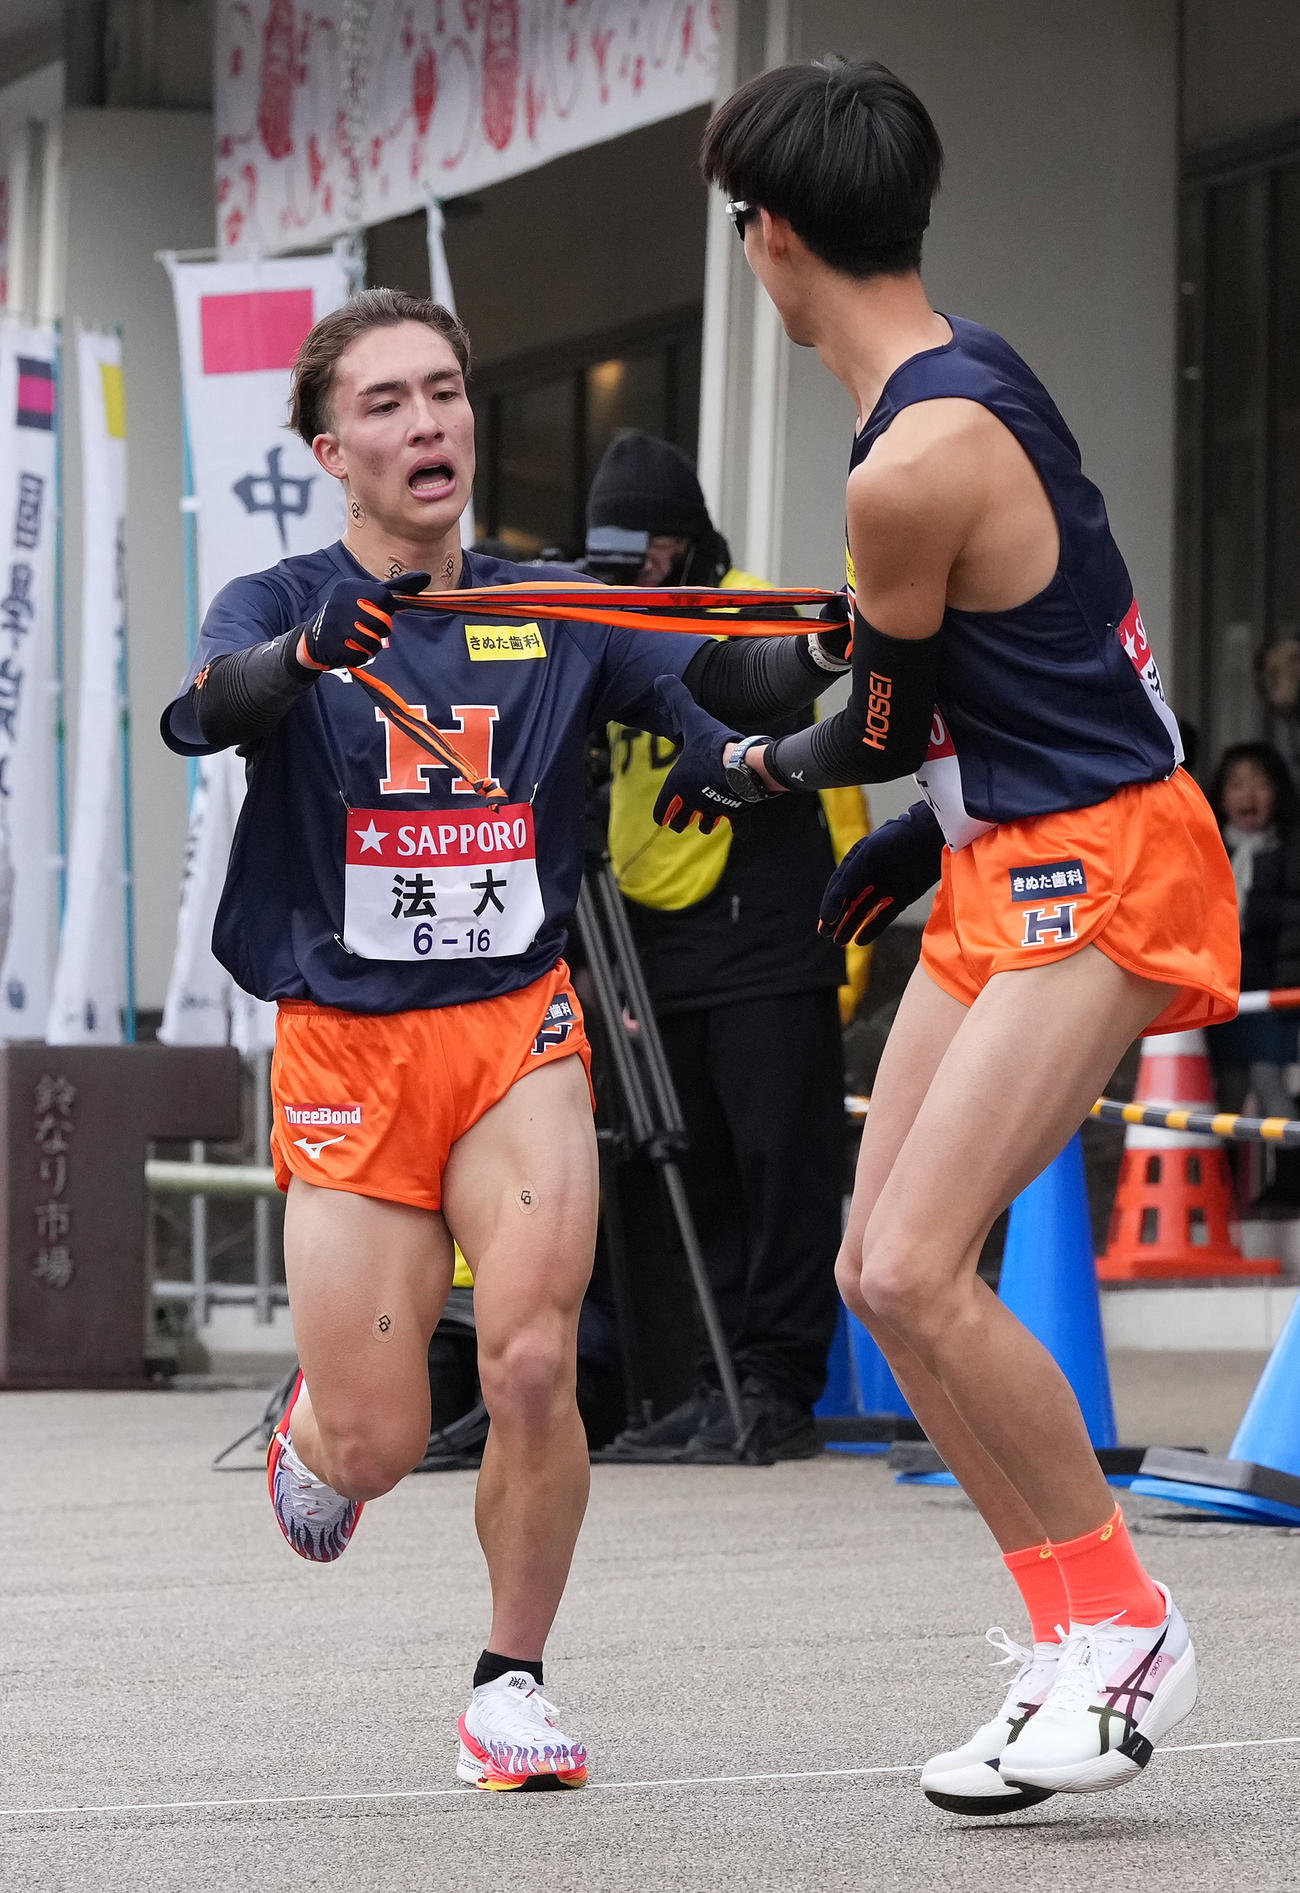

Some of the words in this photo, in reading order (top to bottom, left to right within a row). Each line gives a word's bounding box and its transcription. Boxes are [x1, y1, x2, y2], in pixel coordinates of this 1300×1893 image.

[232, 446, 317, 553] 中
[470, 633, 541, 651] きぬた歯科
[862, 670, 893, 751] HOSEI
[374, 704, 501, 796] H
[701, 786, 742, 808] HOSEI
[396, 818, 528, 857] SAPPORO
[1012, 868, 1083, 893] きぬた歯科
[1021, 901, 1079, 947] H
[284, 1105, 362, 1125] ThreeBond
[32, 1073, 77, 1289] 鈴なり市場
[1149, 1655, 1163, 1679] TOKYO
